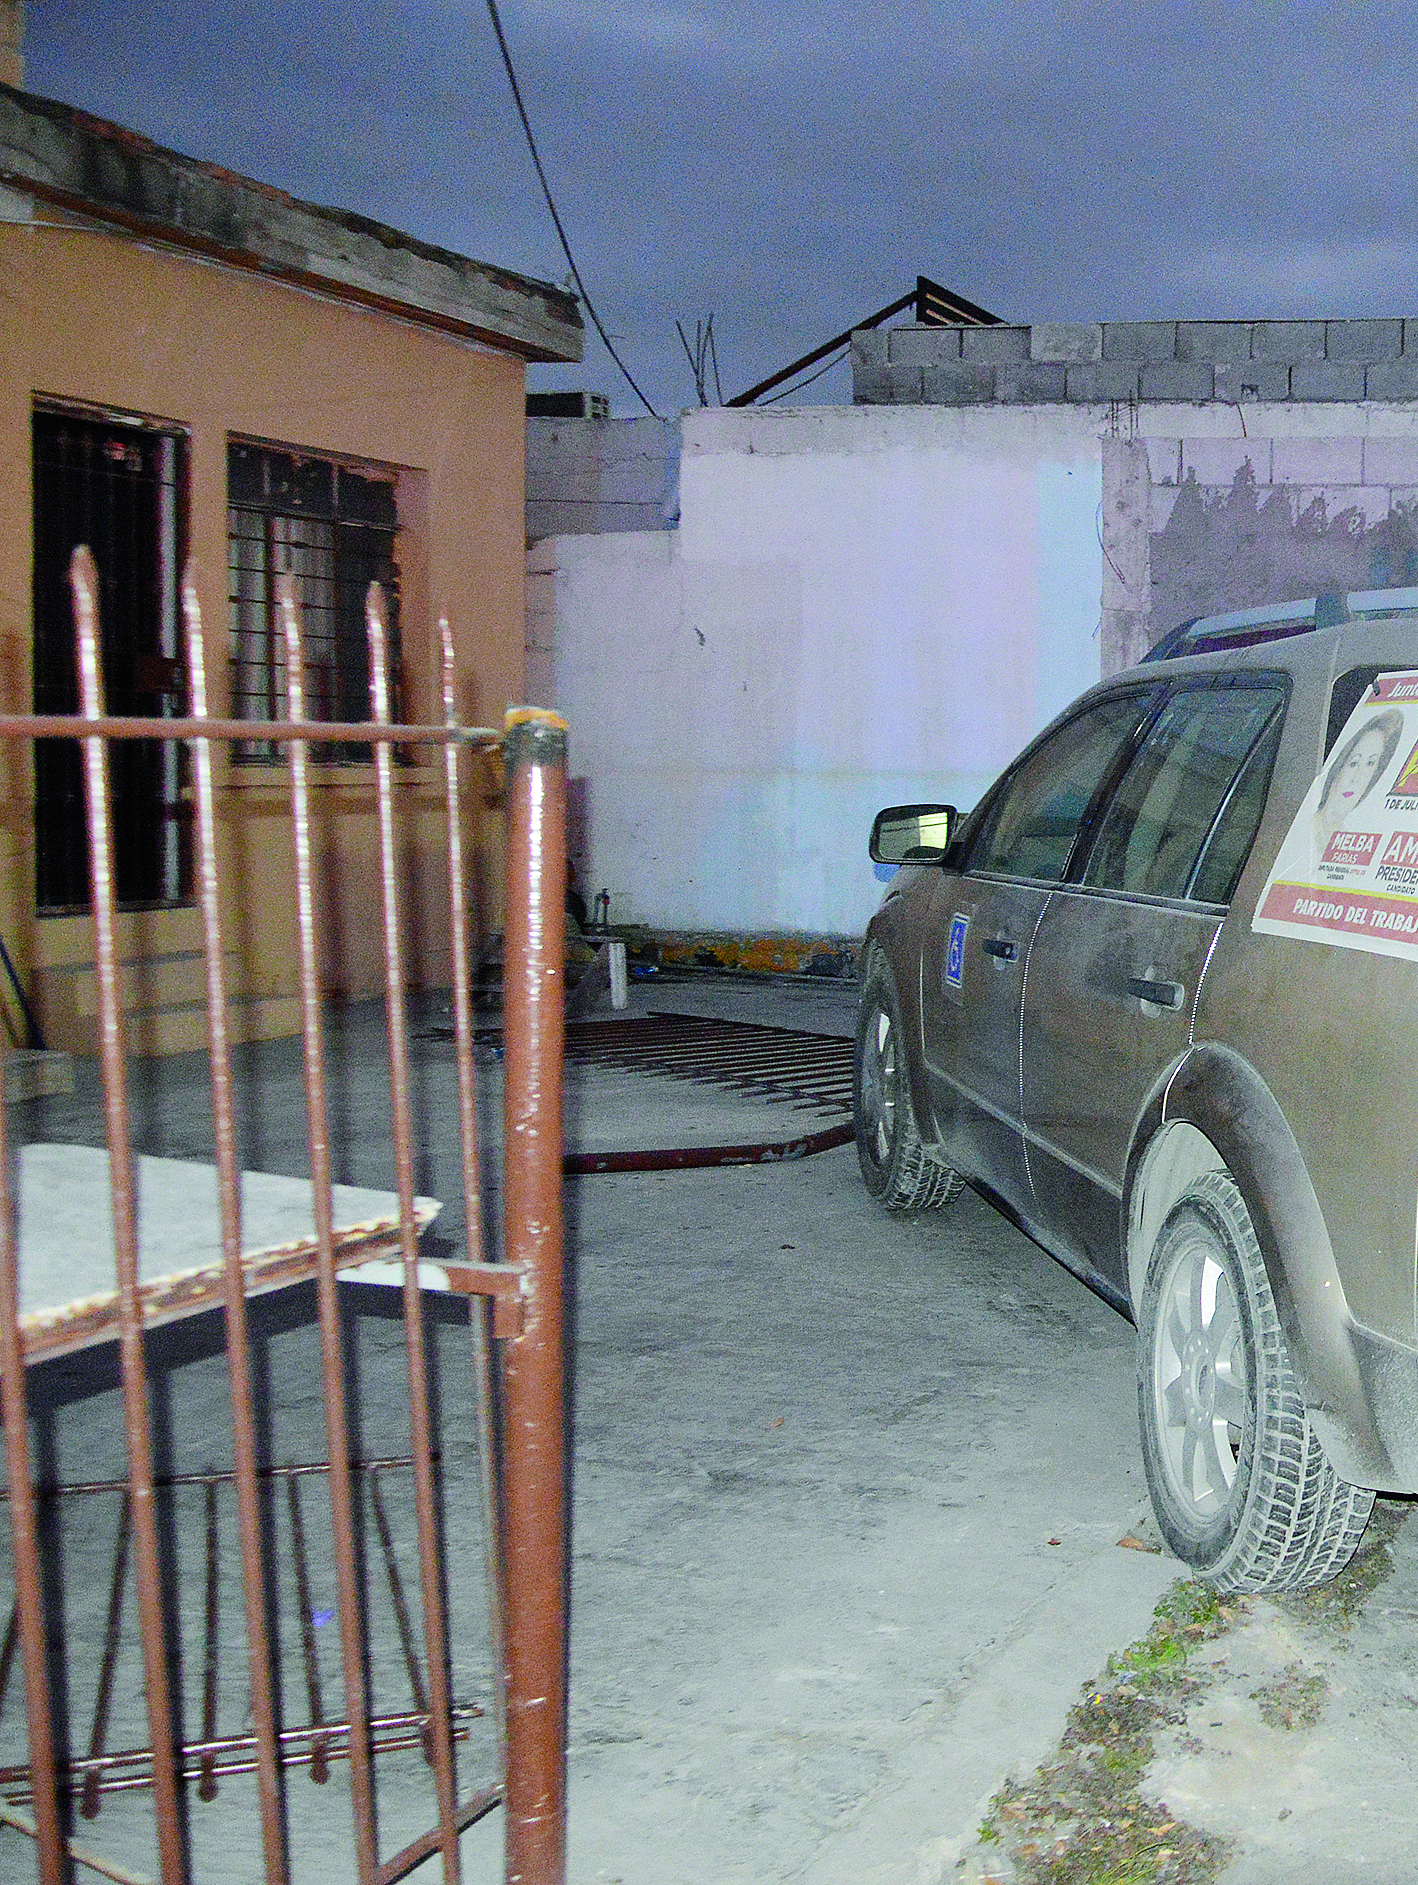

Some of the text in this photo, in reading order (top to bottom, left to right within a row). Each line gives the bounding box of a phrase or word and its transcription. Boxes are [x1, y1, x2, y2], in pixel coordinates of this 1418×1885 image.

[1384, 799, 1390, 809] 1
[1389, 799, 1401, 809] DE
[1331, 833, 1375, 853] MELBA
[1386, 884, 1416, 895] CANDIDATO
[1292, 898, 1344, 921] PARTIDO
[1344, 906, 1368, 925] DEL
